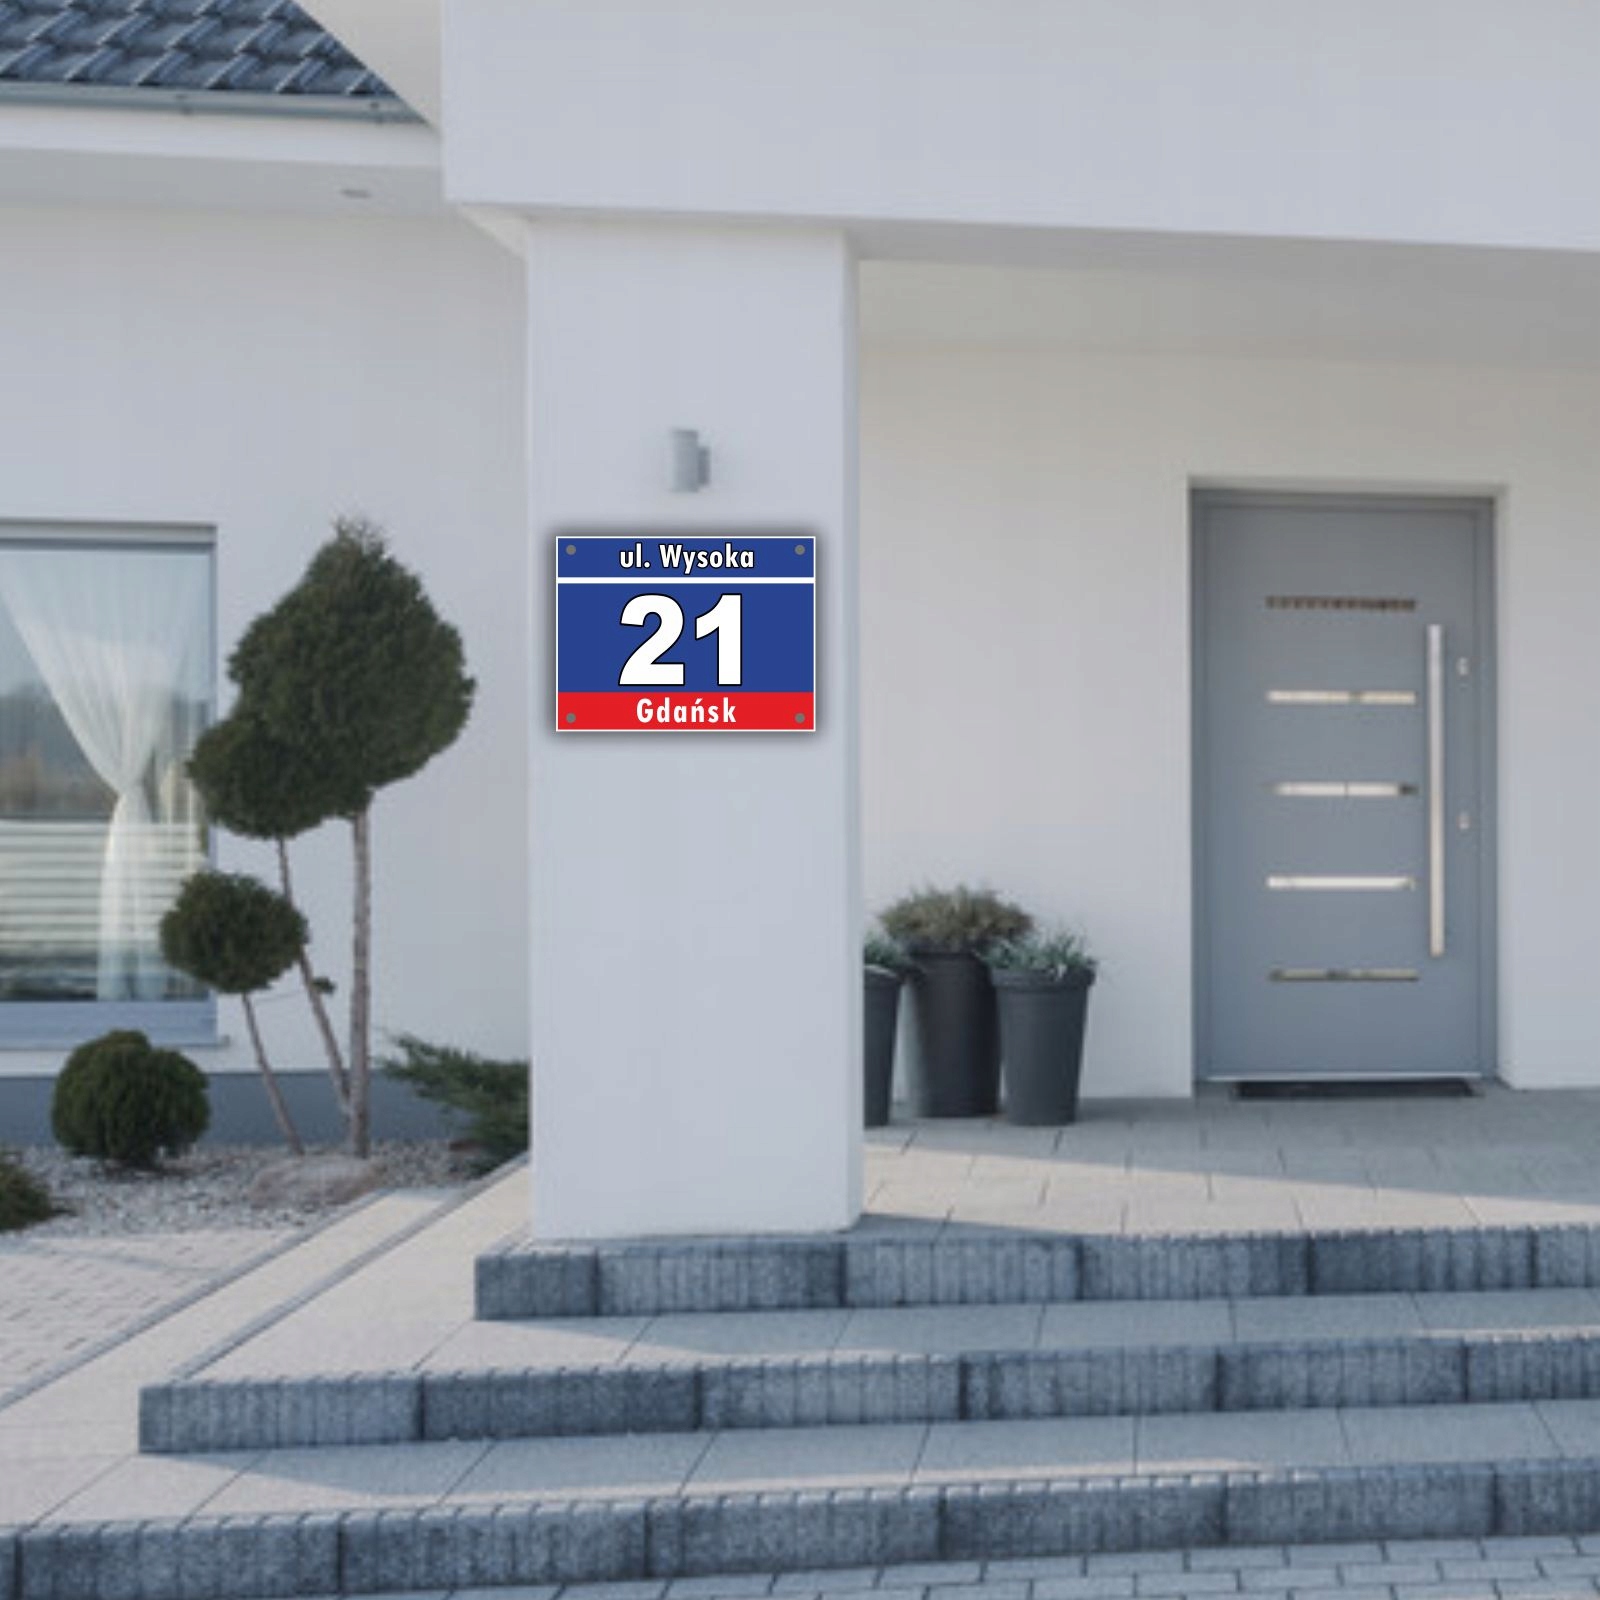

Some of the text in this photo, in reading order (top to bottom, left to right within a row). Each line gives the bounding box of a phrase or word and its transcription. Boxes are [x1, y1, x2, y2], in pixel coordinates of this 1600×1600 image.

[619, 542, 755, 575] ul. Wysoka
[618, 593, 742, 686] 21
[636, 697, 737, 723] Gdańsk
